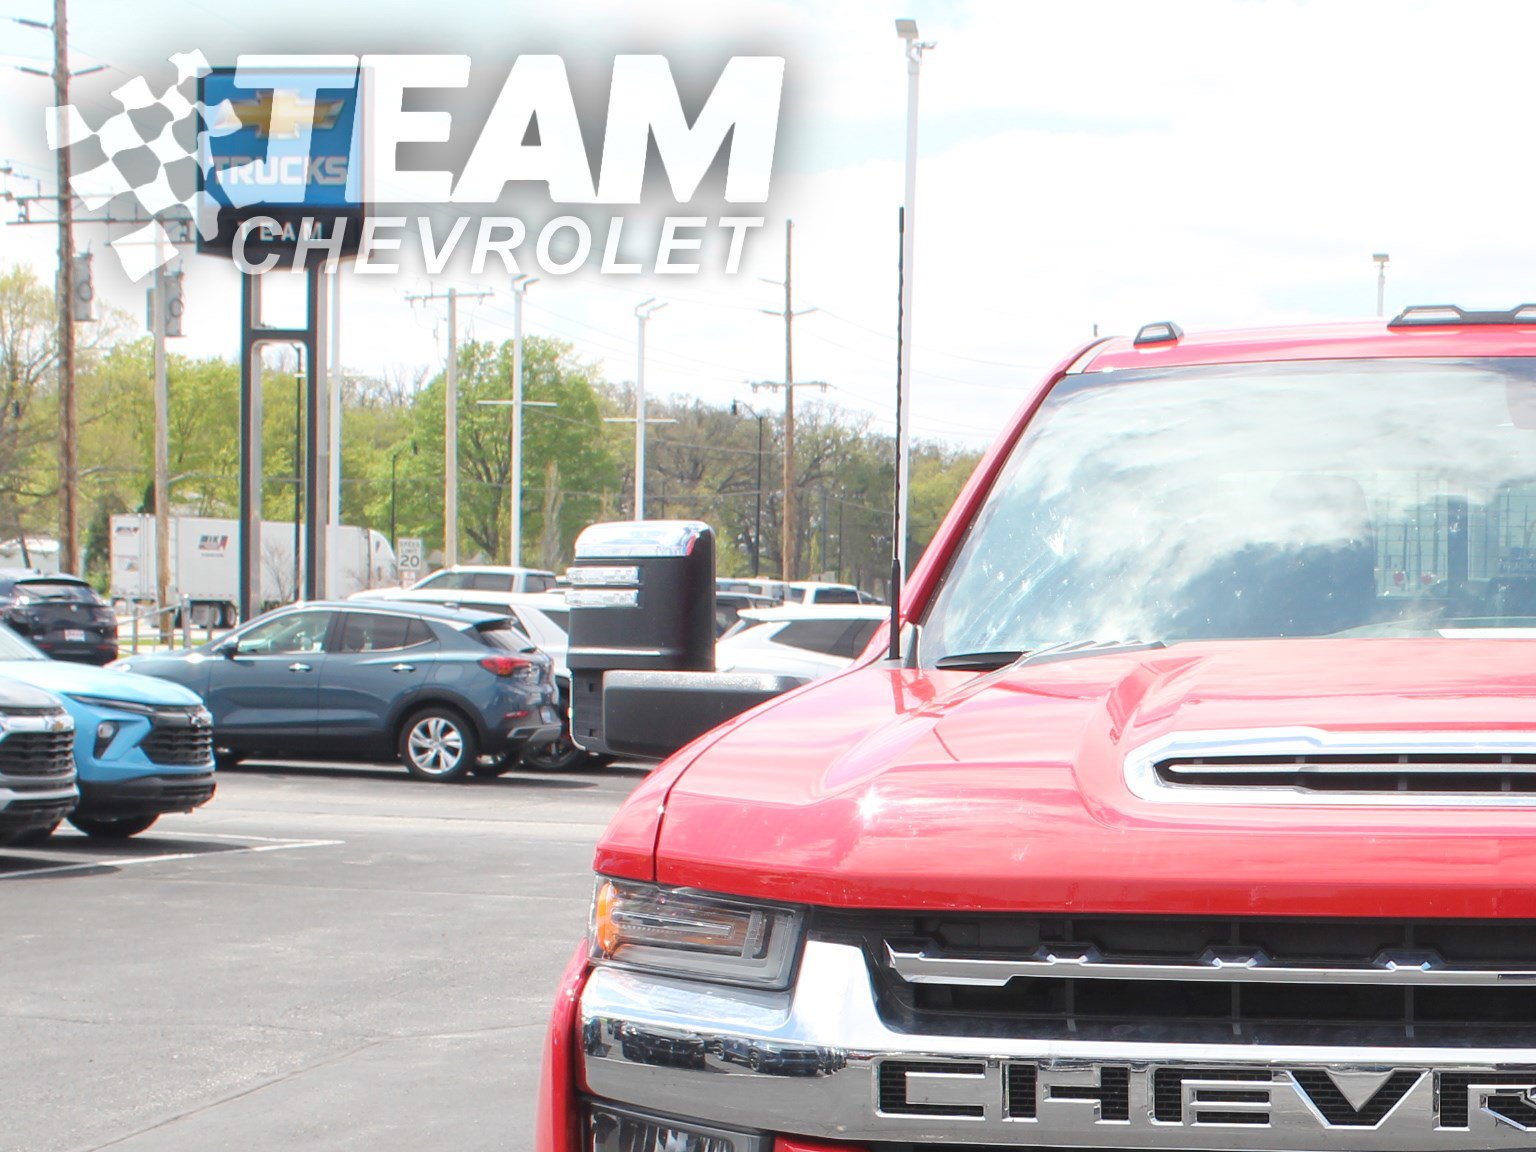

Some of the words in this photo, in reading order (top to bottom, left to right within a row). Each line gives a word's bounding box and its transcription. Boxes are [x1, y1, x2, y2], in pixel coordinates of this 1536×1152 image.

[211, 156, 348, 185] TRUCKS
[238, 221, 323, 241] TEAM
[400, 555, 420, 567] 20
